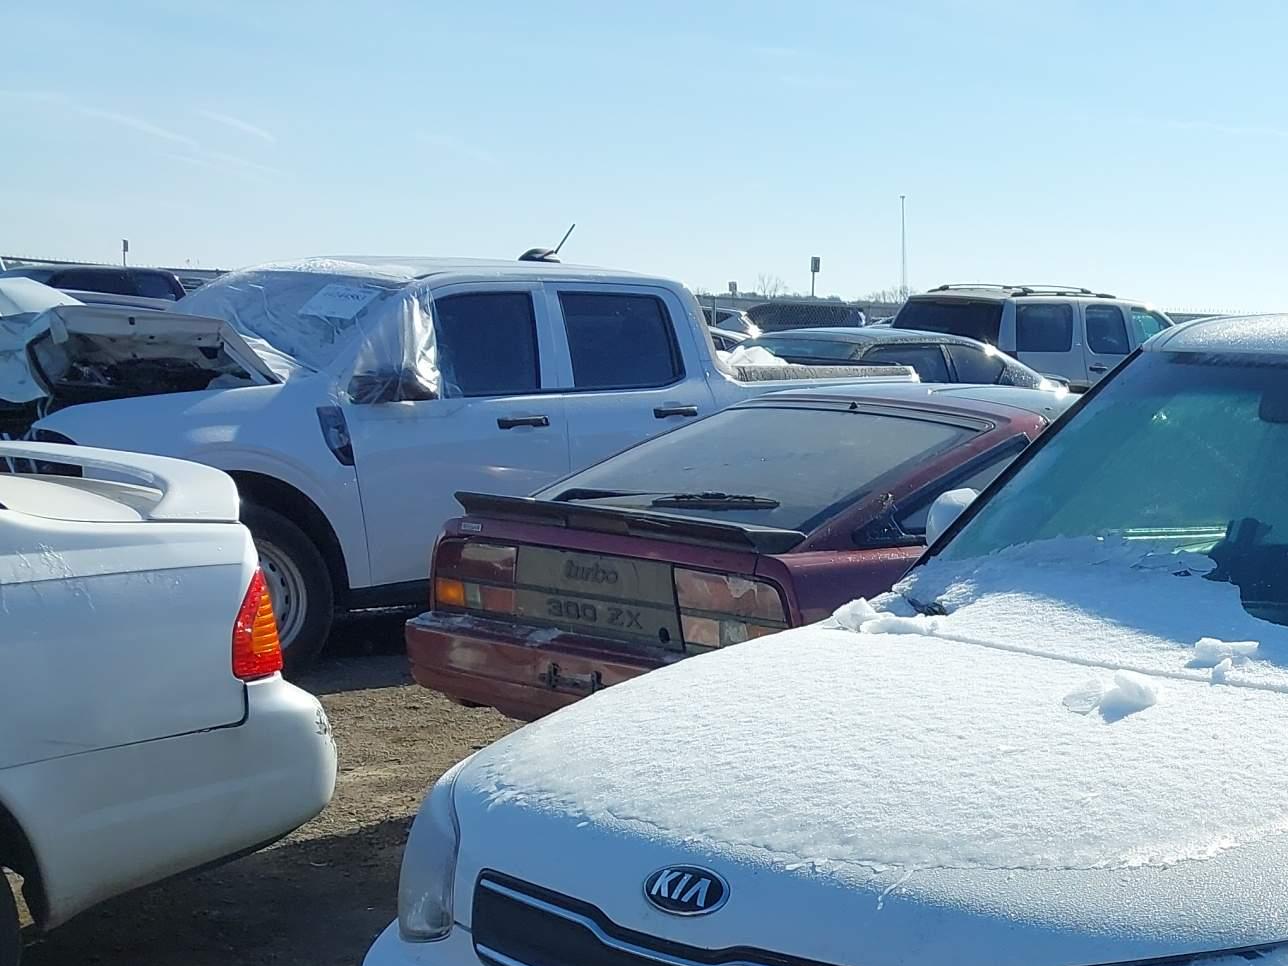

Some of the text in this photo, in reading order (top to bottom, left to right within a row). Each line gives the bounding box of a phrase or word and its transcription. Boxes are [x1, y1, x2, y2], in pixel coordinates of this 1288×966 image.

[564, 559, 619, 584] turbo
[546, 597, 643, 630] 300 ZX
[650, 869, 712, 908] KIA
